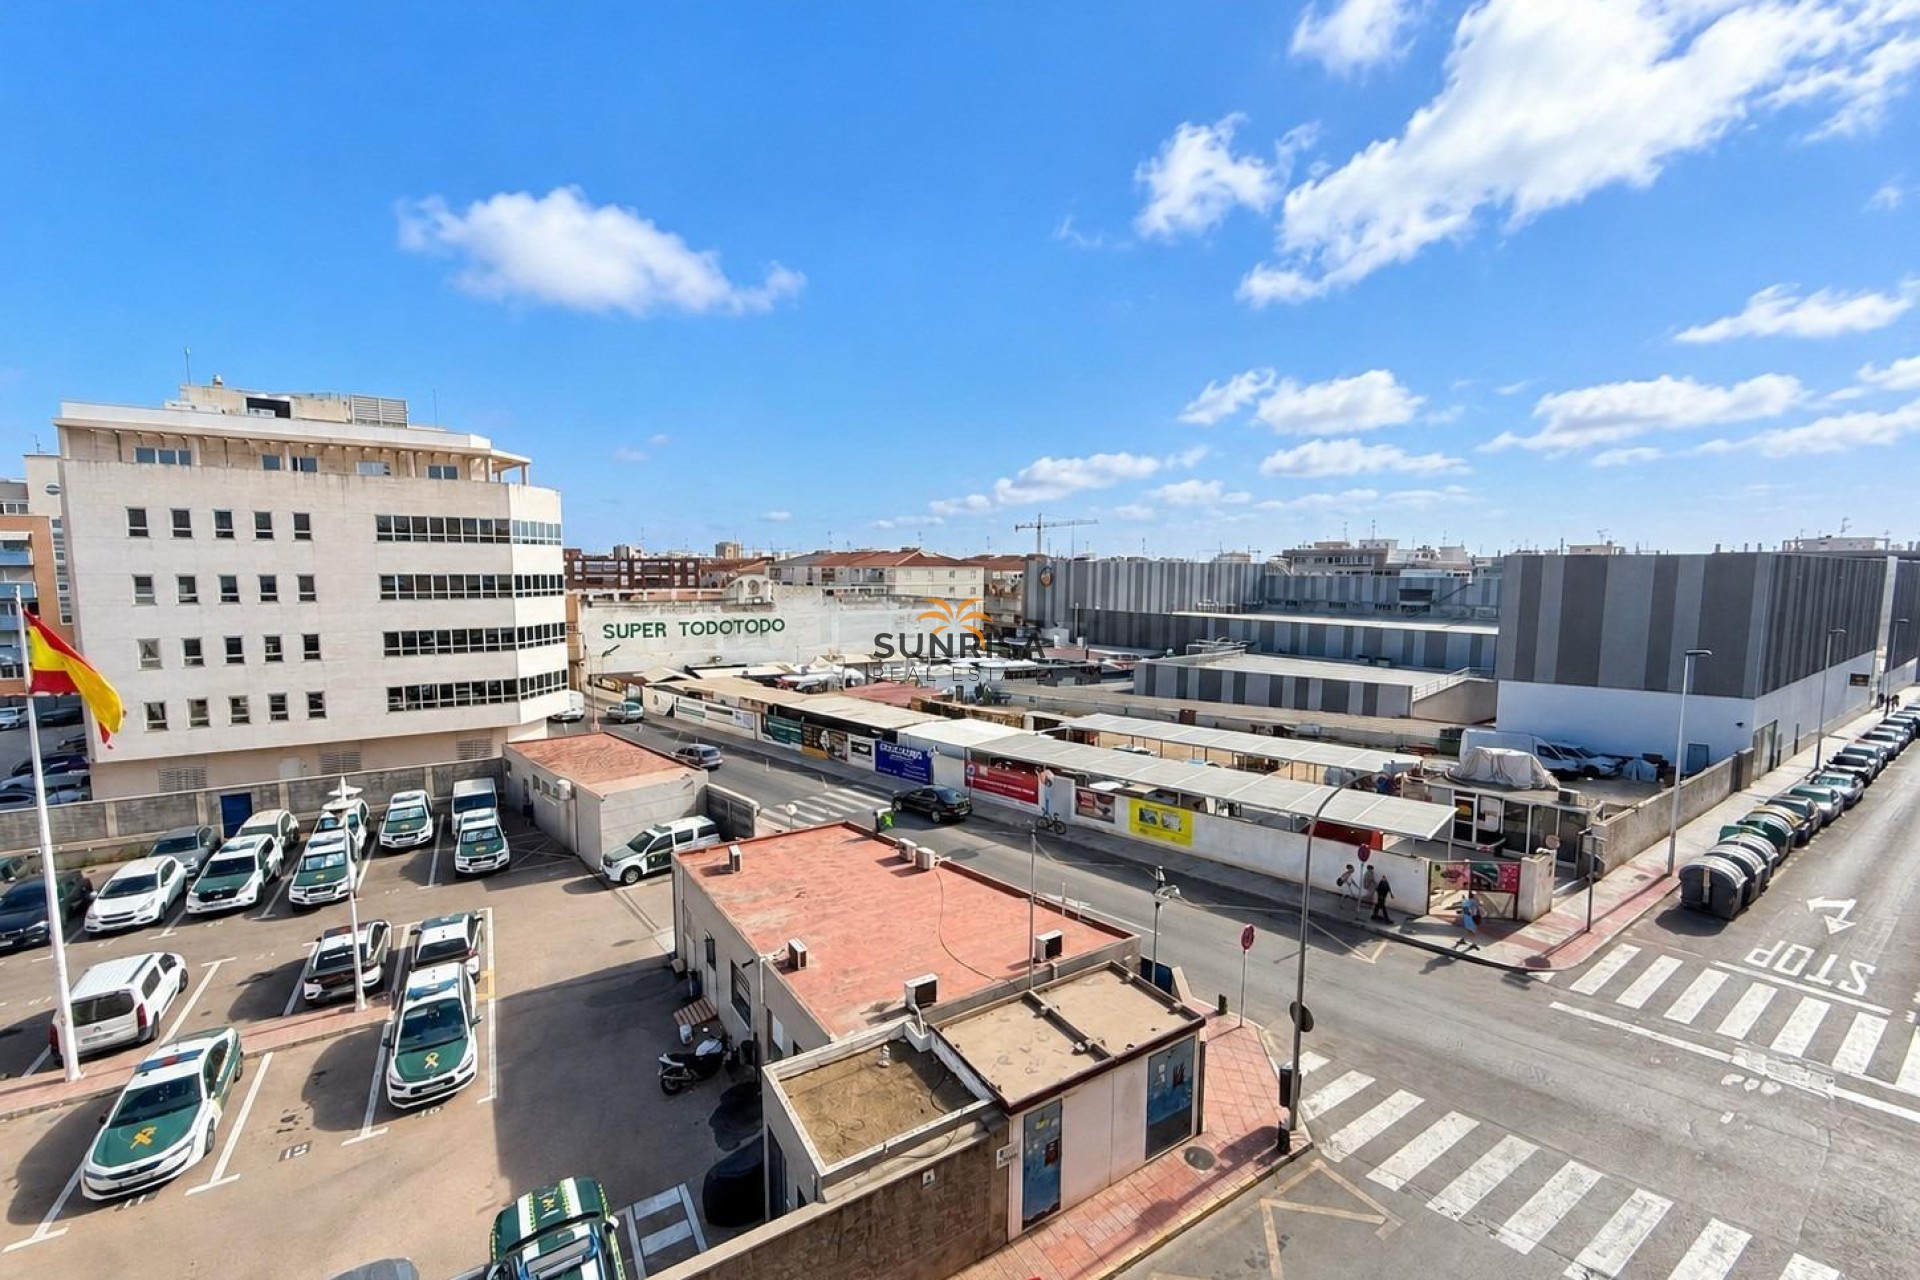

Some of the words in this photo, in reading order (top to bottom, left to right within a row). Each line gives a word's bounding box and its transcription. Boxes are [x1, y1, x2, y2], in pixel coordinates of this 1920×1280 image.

[603, 621, 667, 639] SUPER
[679, 618, 786, 637] TODOTODO
[1744, 941, 1877, 996] STOP
